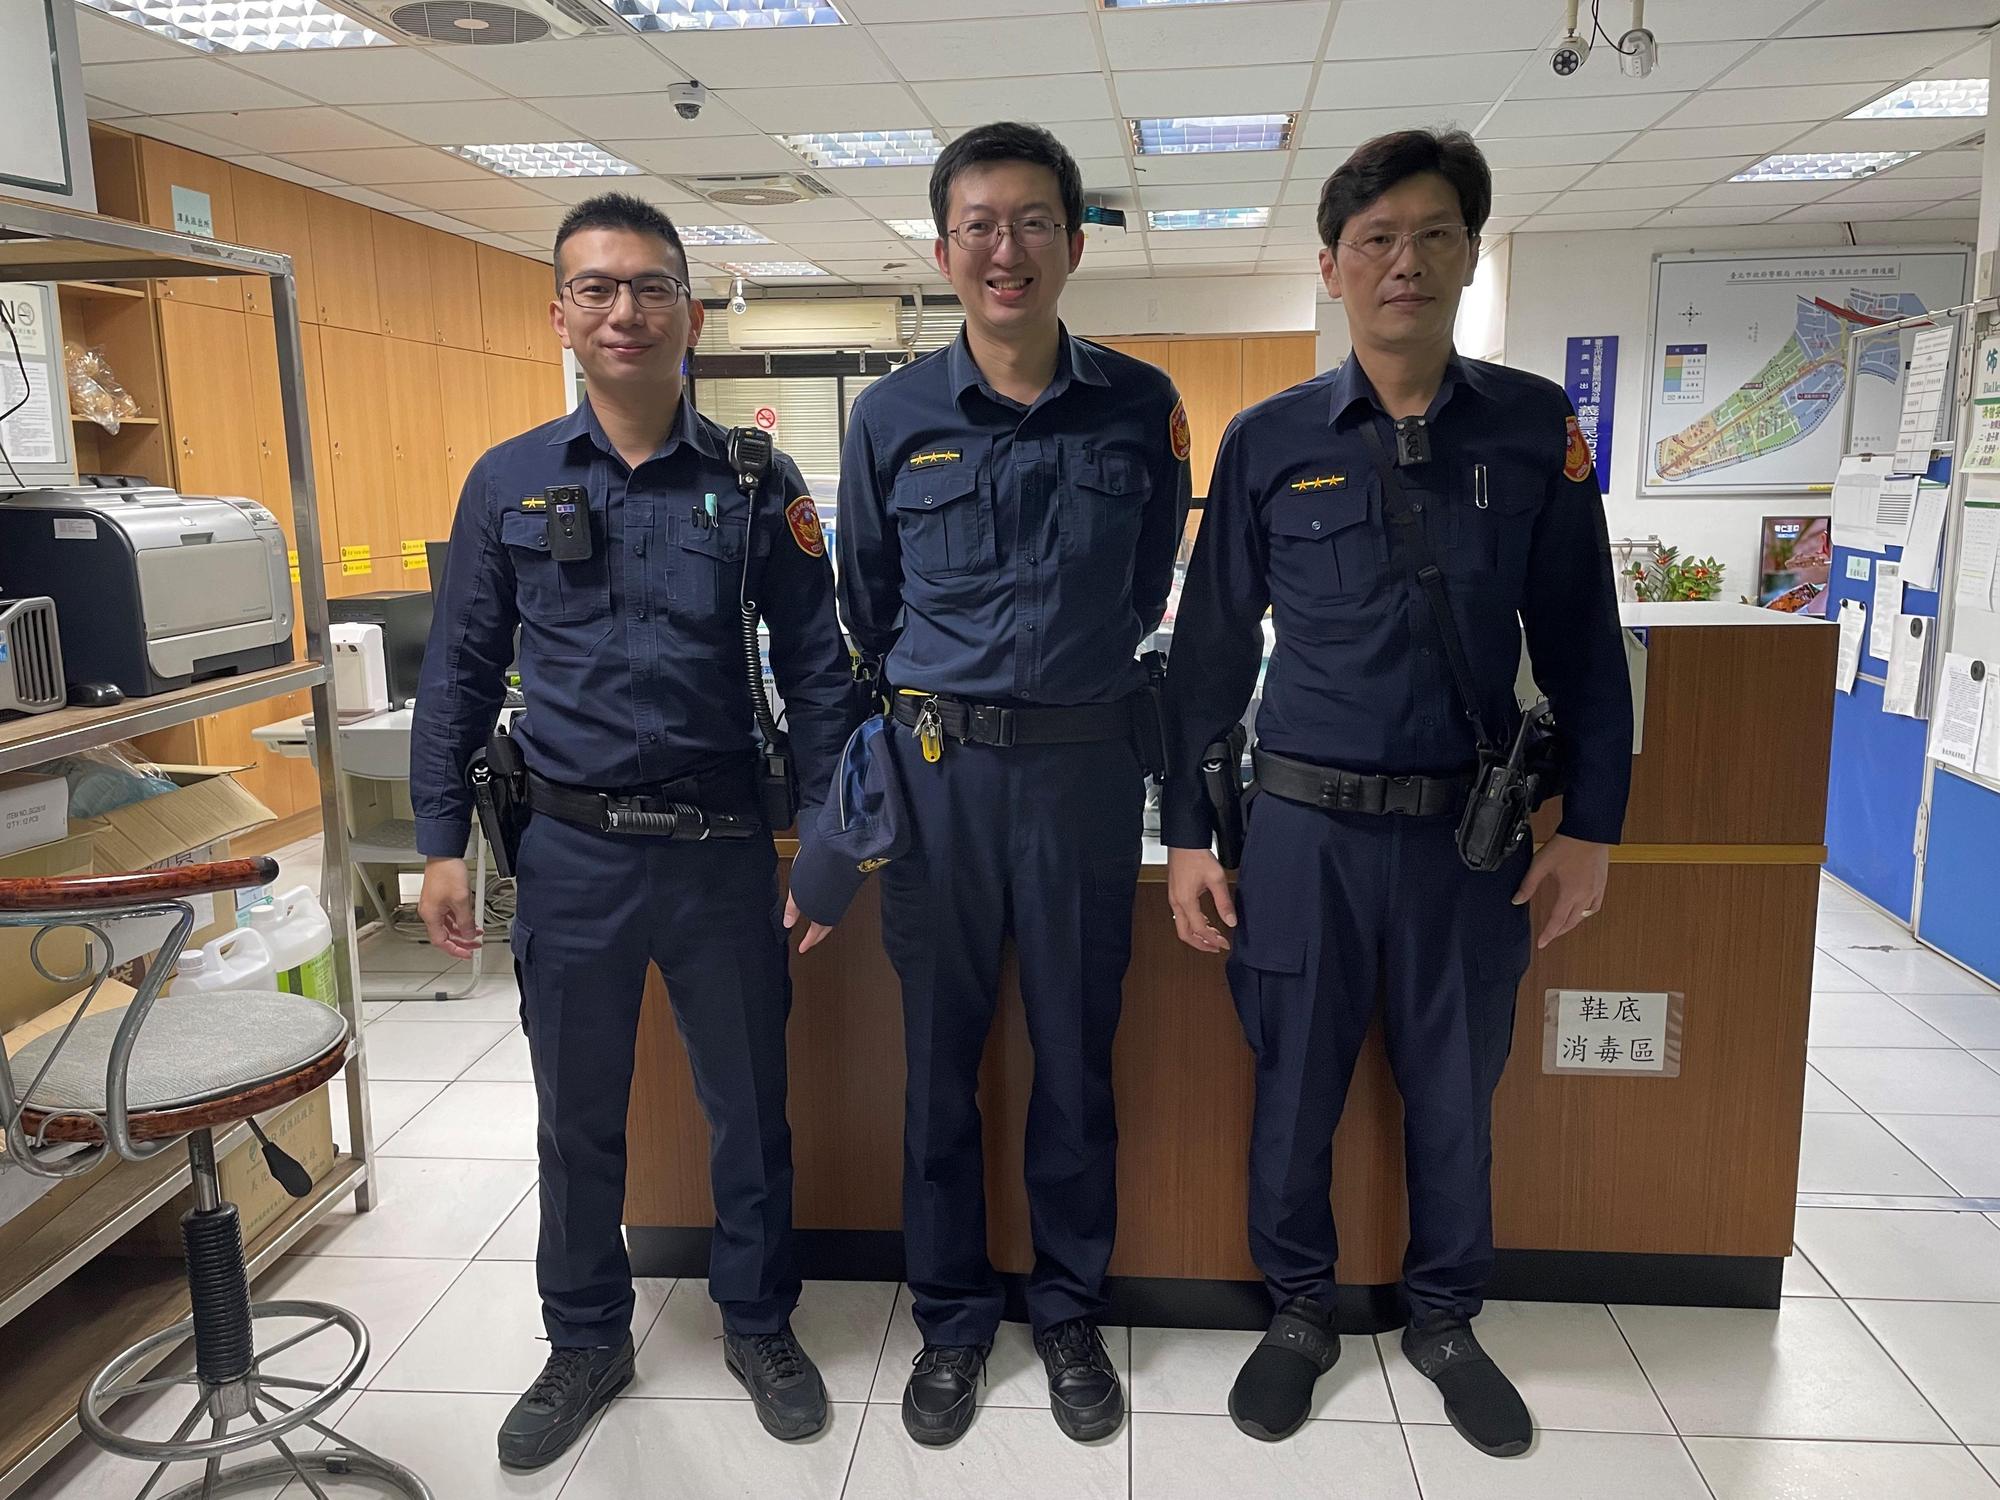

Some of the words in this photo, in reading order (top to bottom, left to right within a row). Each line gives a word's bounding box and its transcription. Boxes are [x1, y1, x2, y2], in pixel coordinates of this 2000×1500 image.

[1579, 996, 1641, 1022] 鞋底
[1563, 1035, 1655, 1064] 消毒區
